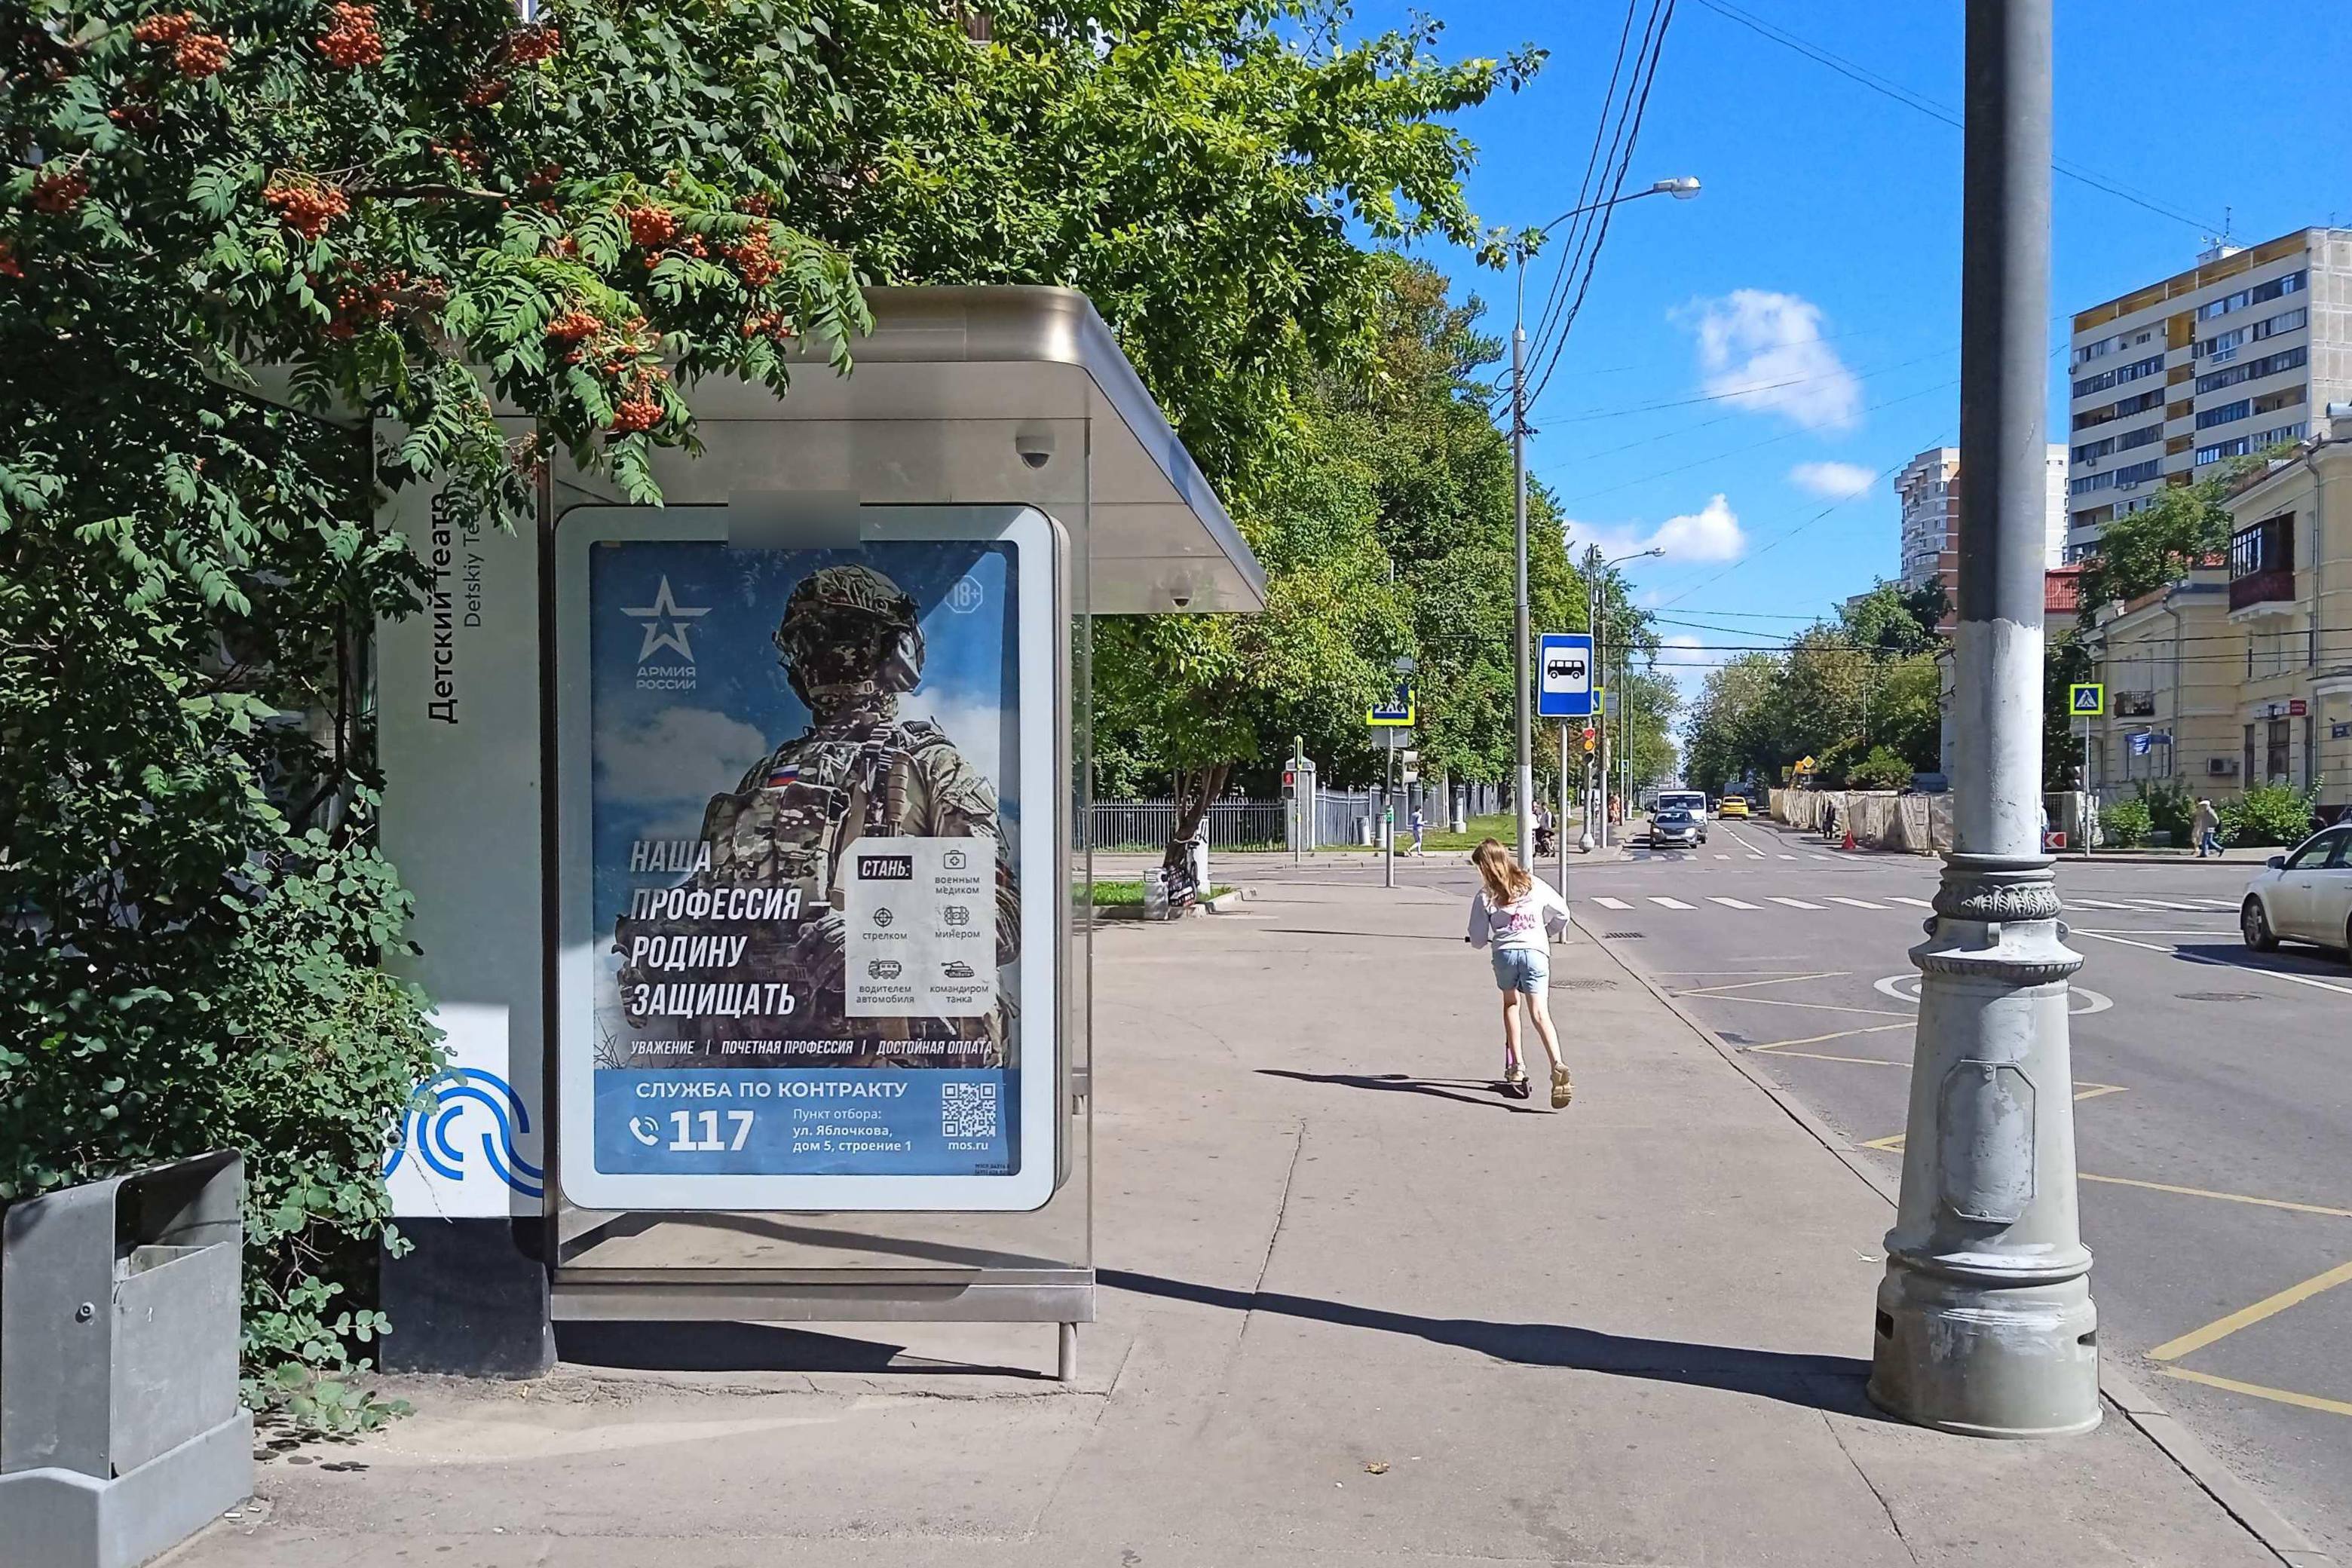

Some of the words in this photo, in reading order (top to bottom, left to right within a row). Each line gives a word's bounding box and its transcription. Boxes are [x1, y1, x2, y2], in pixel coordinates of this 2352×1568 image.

[463, 553, 485, 627] Detskiy
[952, 582, 979, 607] 18+
[427, 592, 458, 724] Детский
[636, 666, 696, 677] АРМИЯ
[635, 679, 696, 689] РОССИИ
[629, 841, 711, 872] НАША
[862, 860, 910, 877] СТАНЬ:
[935, 876, 980, 884] военным
[936, 886, 979, 895] медиком
[630, 888, 802, 920] ПРОФЕССИЯ
[862, 933, 908, 941] стрелком
[935, 931, 980, 940] минером
[630, 936, 748, 972] РОДИНУ
[859, 985, 911, 994] водителем
[930, 985, 988, 994] командиром
[631, 983, 795, 1018] ЗАЩИЩАТЬ
[856, 995, 914, 1003] автомобиля
[631, 1040, 695, 1055] УВАЖЕНИЕ
[721, 1040, 782, 1055] ПОЧЕТНАЯ
[783, 1040, 853, 1055] ПРОФЕССИЯ
[876, 1038, 945, 1055] ДОСТОЙНАЯ
[948, 1040, 993, 1055] ОПЛАТА
[635, 1083, 733, 1098] СЛУЖБА
[740, 1083, 771, 1098] ПО
[779, 1082, 908, 1098] КОНТРАКТУ
[793, 1109, 830, 1121] Пункт
[834, 1109, 881, 1121] отбора:
[669, 1110, 754, 1151] 117
[793, 1127, 812, 1137] ул.
[816, 1125, 893, 1138] Яблочкова,
[793, 1142, 820, 1153] дом
[824, 1141, 835, 1152] 5,
[839, 1142, 901, 1153] строение
[905, 1141, 911, 1150] 1
[948, 1141, 988, 1150] mos.ru
